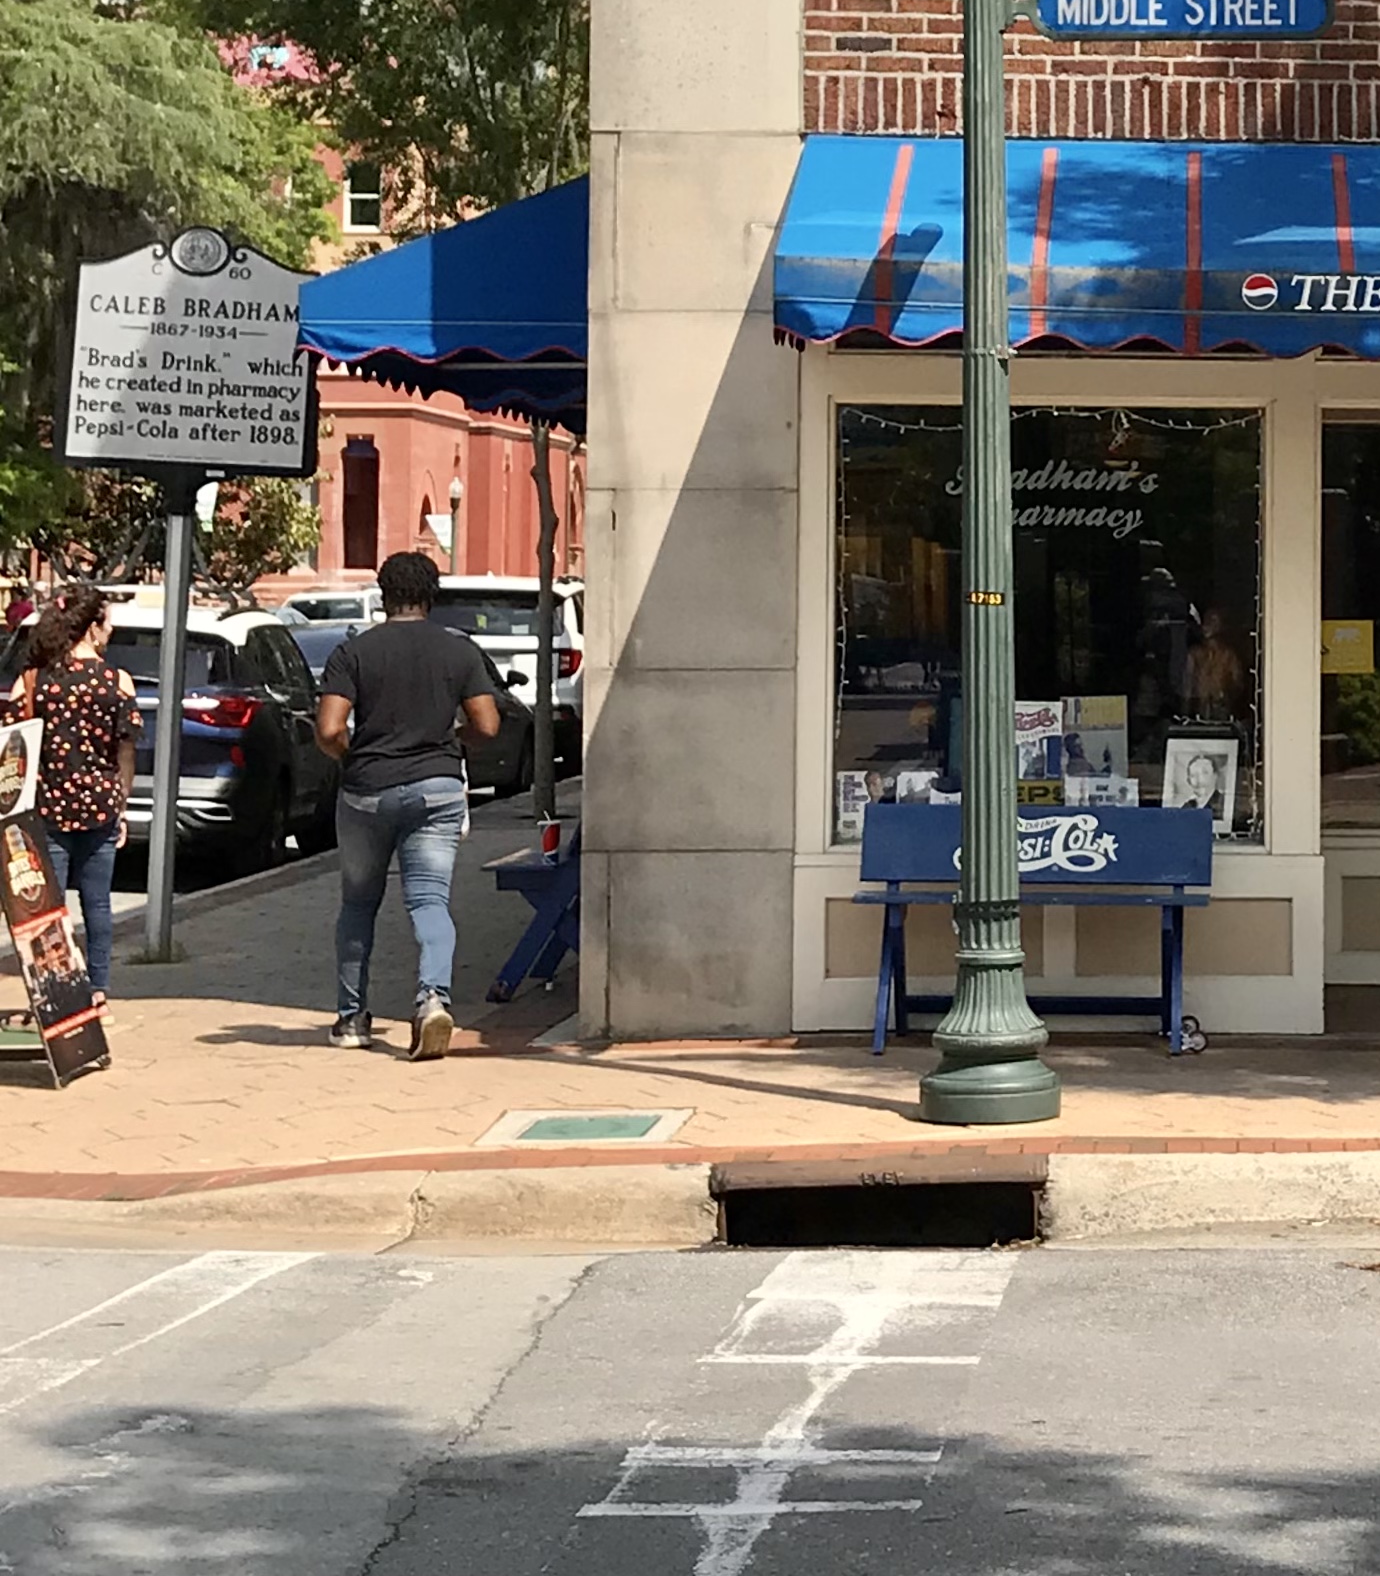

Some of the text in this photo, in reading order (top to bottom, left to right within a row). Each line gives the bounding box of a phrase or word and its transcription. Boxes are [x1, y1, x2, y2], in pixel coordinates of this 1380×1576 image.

[228, 267, 252, 280] 60
[90, 294, 300, 322] CALEB BRADHAM
[150, 322, 238, 340] 1867-1934
[247, 356, 304, 377] which
[78, 371, 301, 404] he created in pharmacy
[136, 400, 172, 417] was
[178, 400, 272, 422] marketed
[279, 407, 301, 423] as
[74, 416, 179, 440] Pepsi-Cola
[189, 424, 242, 443] after
